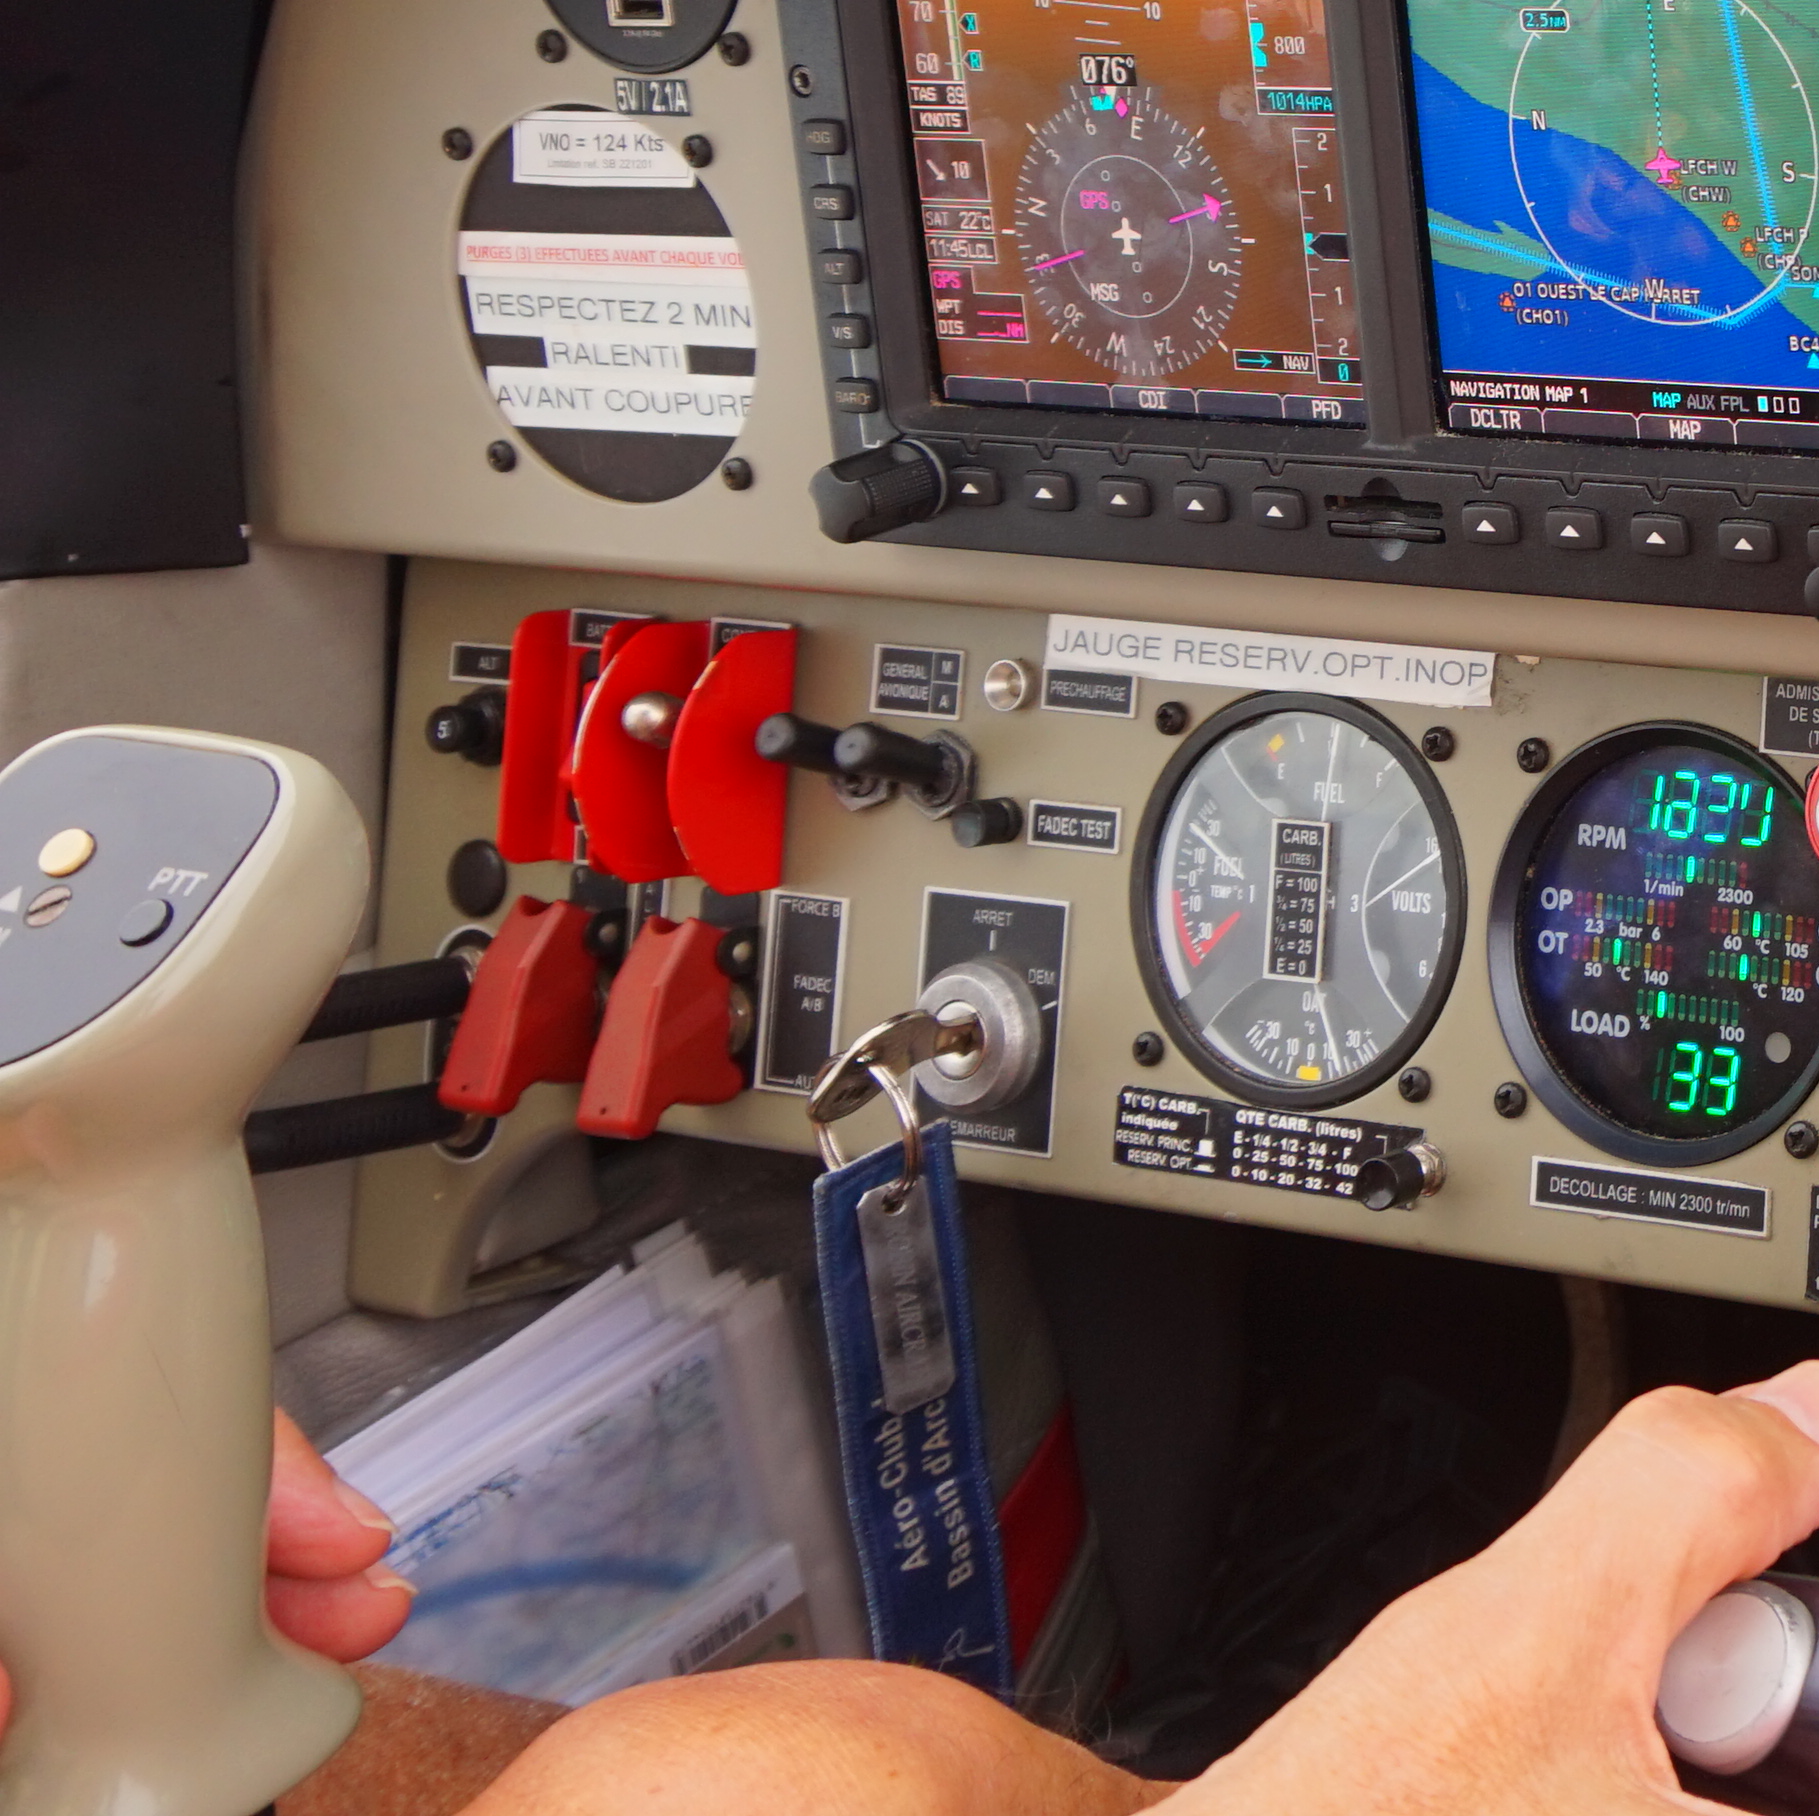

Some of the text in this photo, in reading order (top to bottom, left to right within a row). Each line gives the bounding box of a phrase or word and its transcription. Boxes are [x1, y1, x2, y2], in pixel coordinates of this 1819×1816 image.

[920, 113, 962, 128] KNOTS
[539, 133, 570, 151] VNO
[594, 135, 626, 150] 124
[634, 135, 664, 151] Kts
[467, 246, 743, 266] PURGES (3) EFFECTUEES AVANT CHAQUE VOL
[476, 293, 751, 327] RESPECTEZ 2 MIN
[550, 342, 678, 368] RALENTI
[498, 385, 752, 417] AVANT COUPURE
[1450, 380, 1588, 404] NAVIGATION MAP 1
[1053, 629, 1488, 687] JAUGE RESERV.OPT.INOP
[1789, 706, 1808, 723] DE
[1038, 815, 1111, 839] FADEC TEST
[1578, 824, 1626, 850] RPM
[148, 867, 208, 896] PTT
[1392, 891, 1431, 914] VOLTS
[1718, 888, 1753, 905] 2300
[973, 909, 1012, 926] ARRET
[1570, 1009, 1630, 1037] LOAD
[1550, 1176, 1638, 1203] DECOLLAGE
[1648, 1191, 1676, 1209] MIN
[1680, 1194, 1712, 1213] 2300
[1716, 1197, 1750, 1218] tr/mn
[935, 1476, 974, 1590] Bassin
